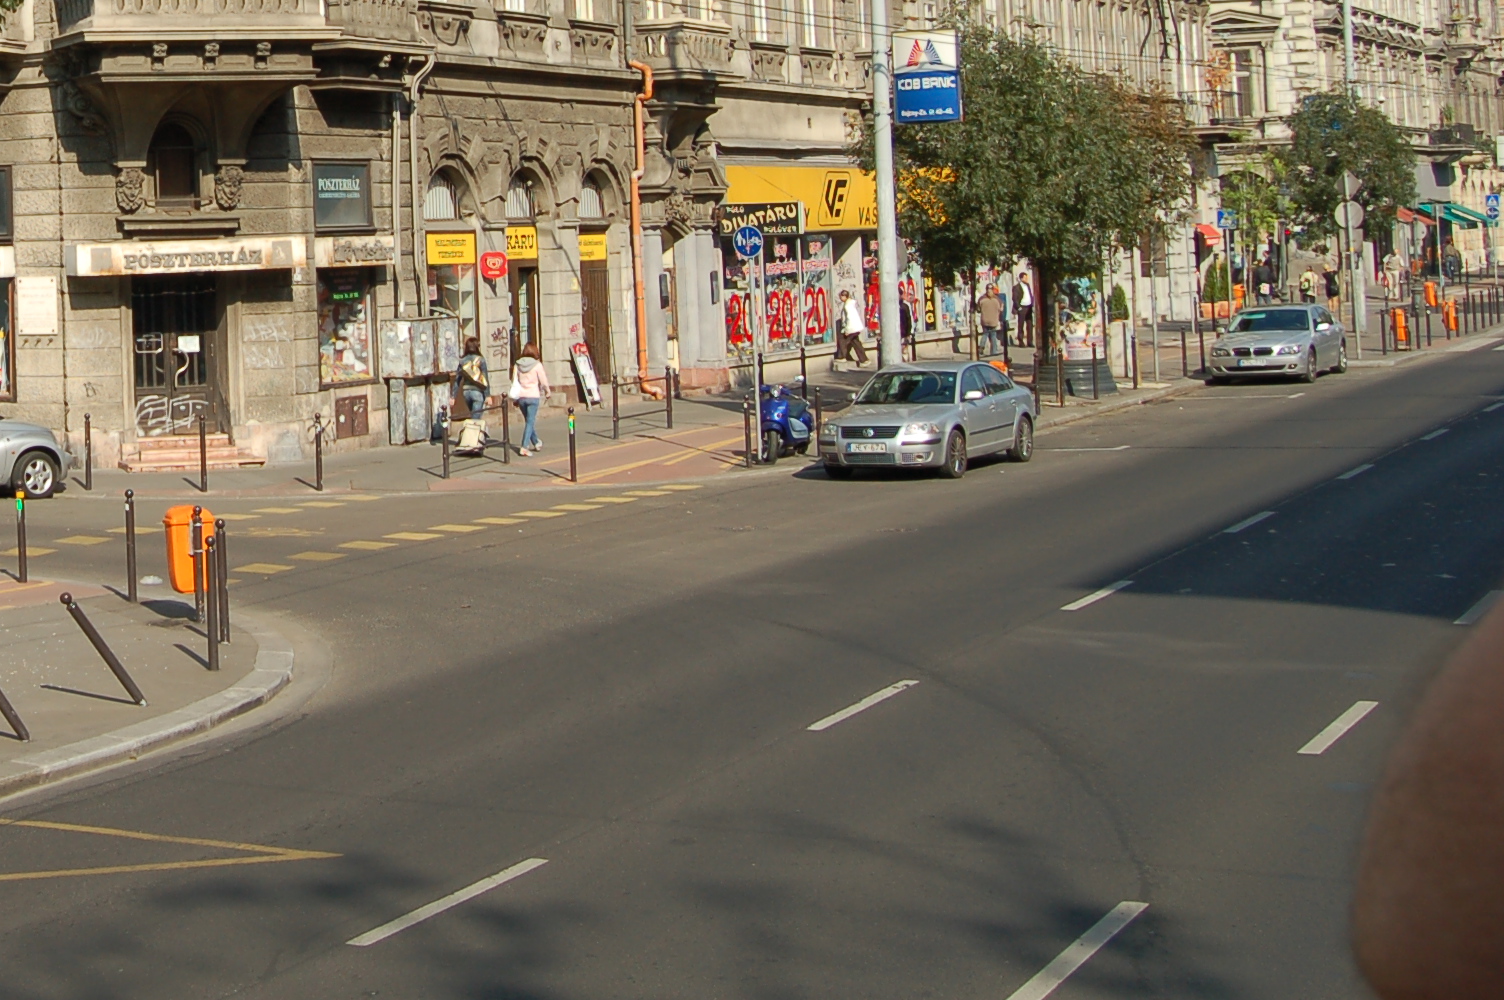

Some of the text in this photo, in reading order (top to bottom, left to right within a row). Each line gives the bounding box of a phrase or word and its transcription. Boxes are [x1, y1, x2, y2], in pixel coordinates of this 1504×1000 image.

[922, 76, 956, 89] BANK
[318, 175, 360, 191] POSZTERHÁZ
[722, 204, 796, 233] DIVATÁRU
[123, 246, 263, 270] POSZTERHÁZ
